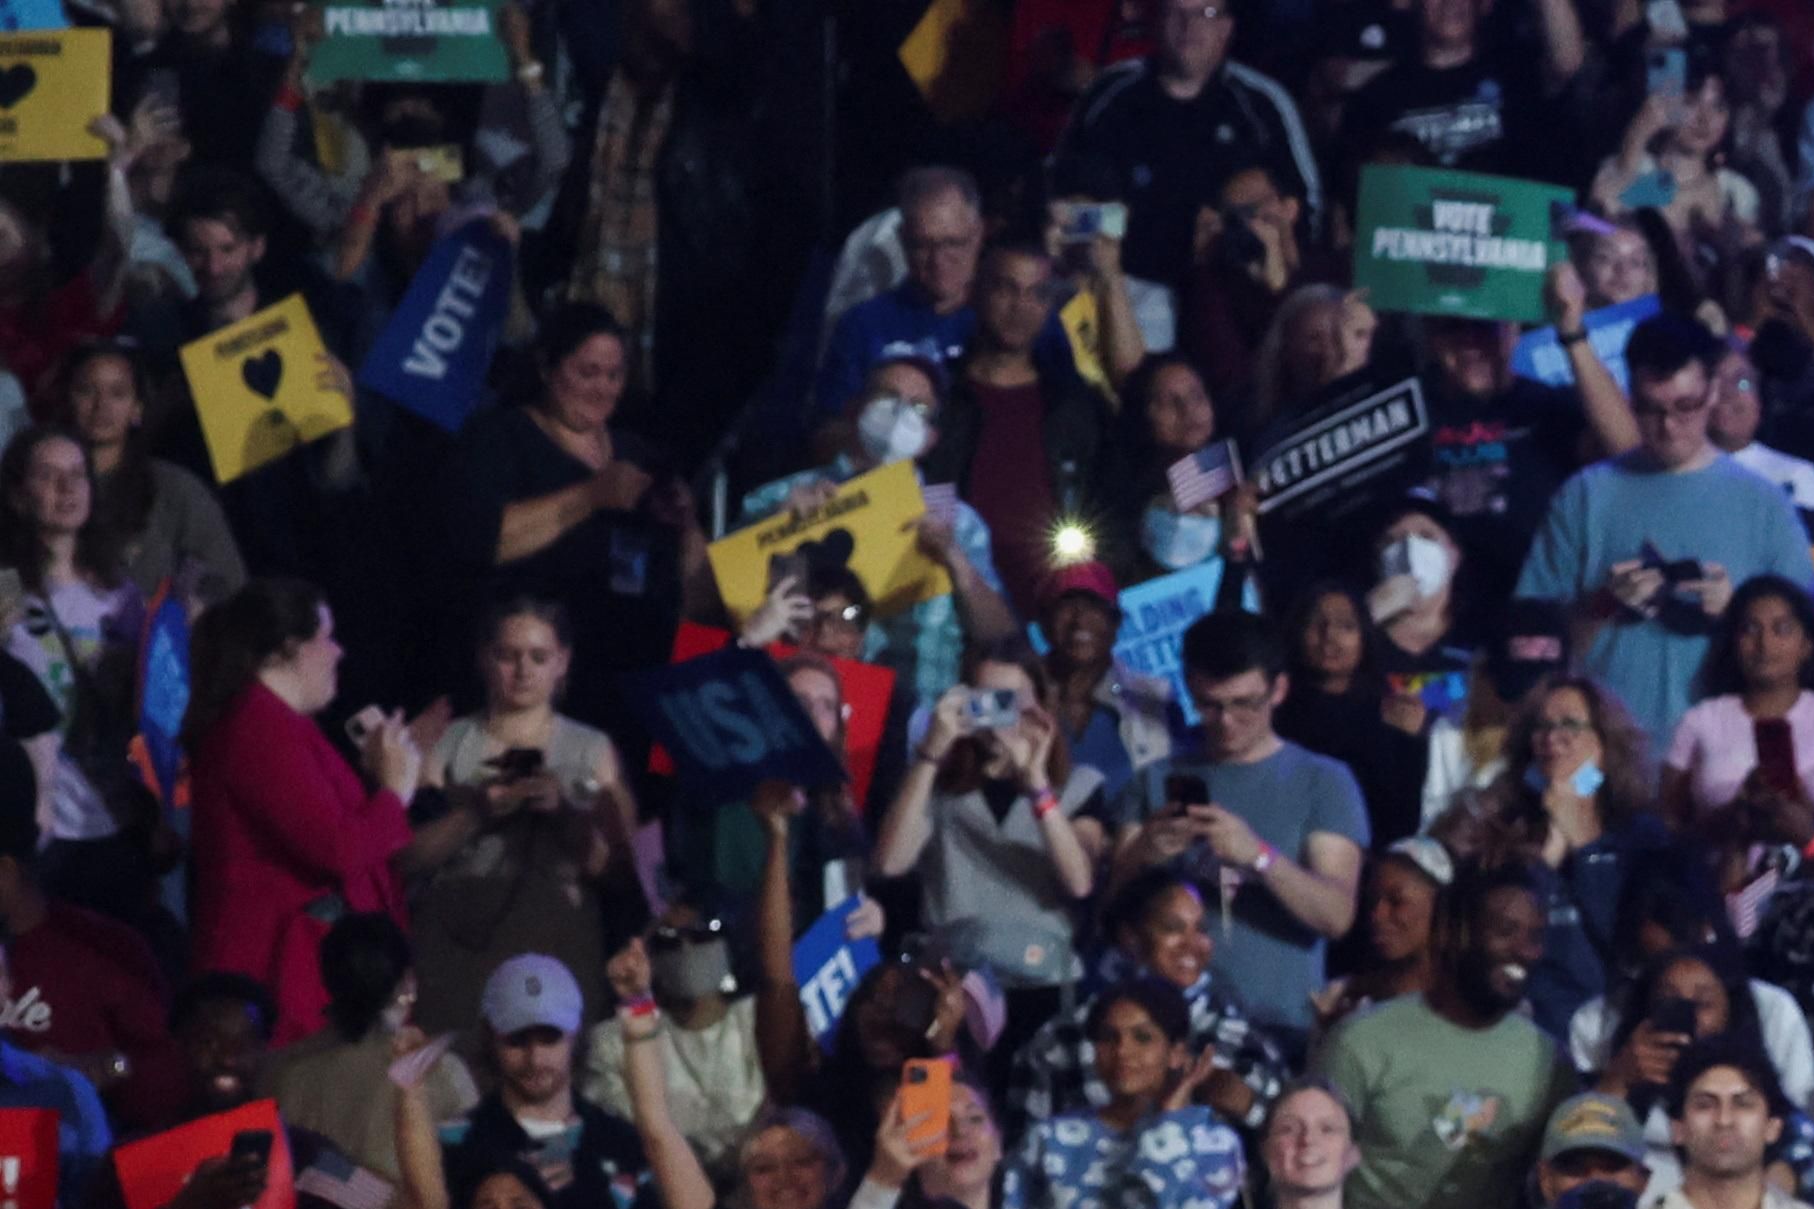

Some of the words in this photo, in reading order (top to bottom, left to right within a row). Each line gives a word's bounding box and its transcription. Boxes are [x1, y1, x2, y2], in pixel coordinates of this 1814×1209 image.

[1432, 199, 1494, 236] VOTE
[1372, 226, 1547, 271] PENNSYLVANIA
[1257, 399, 1411, 494] FETTERMAN
